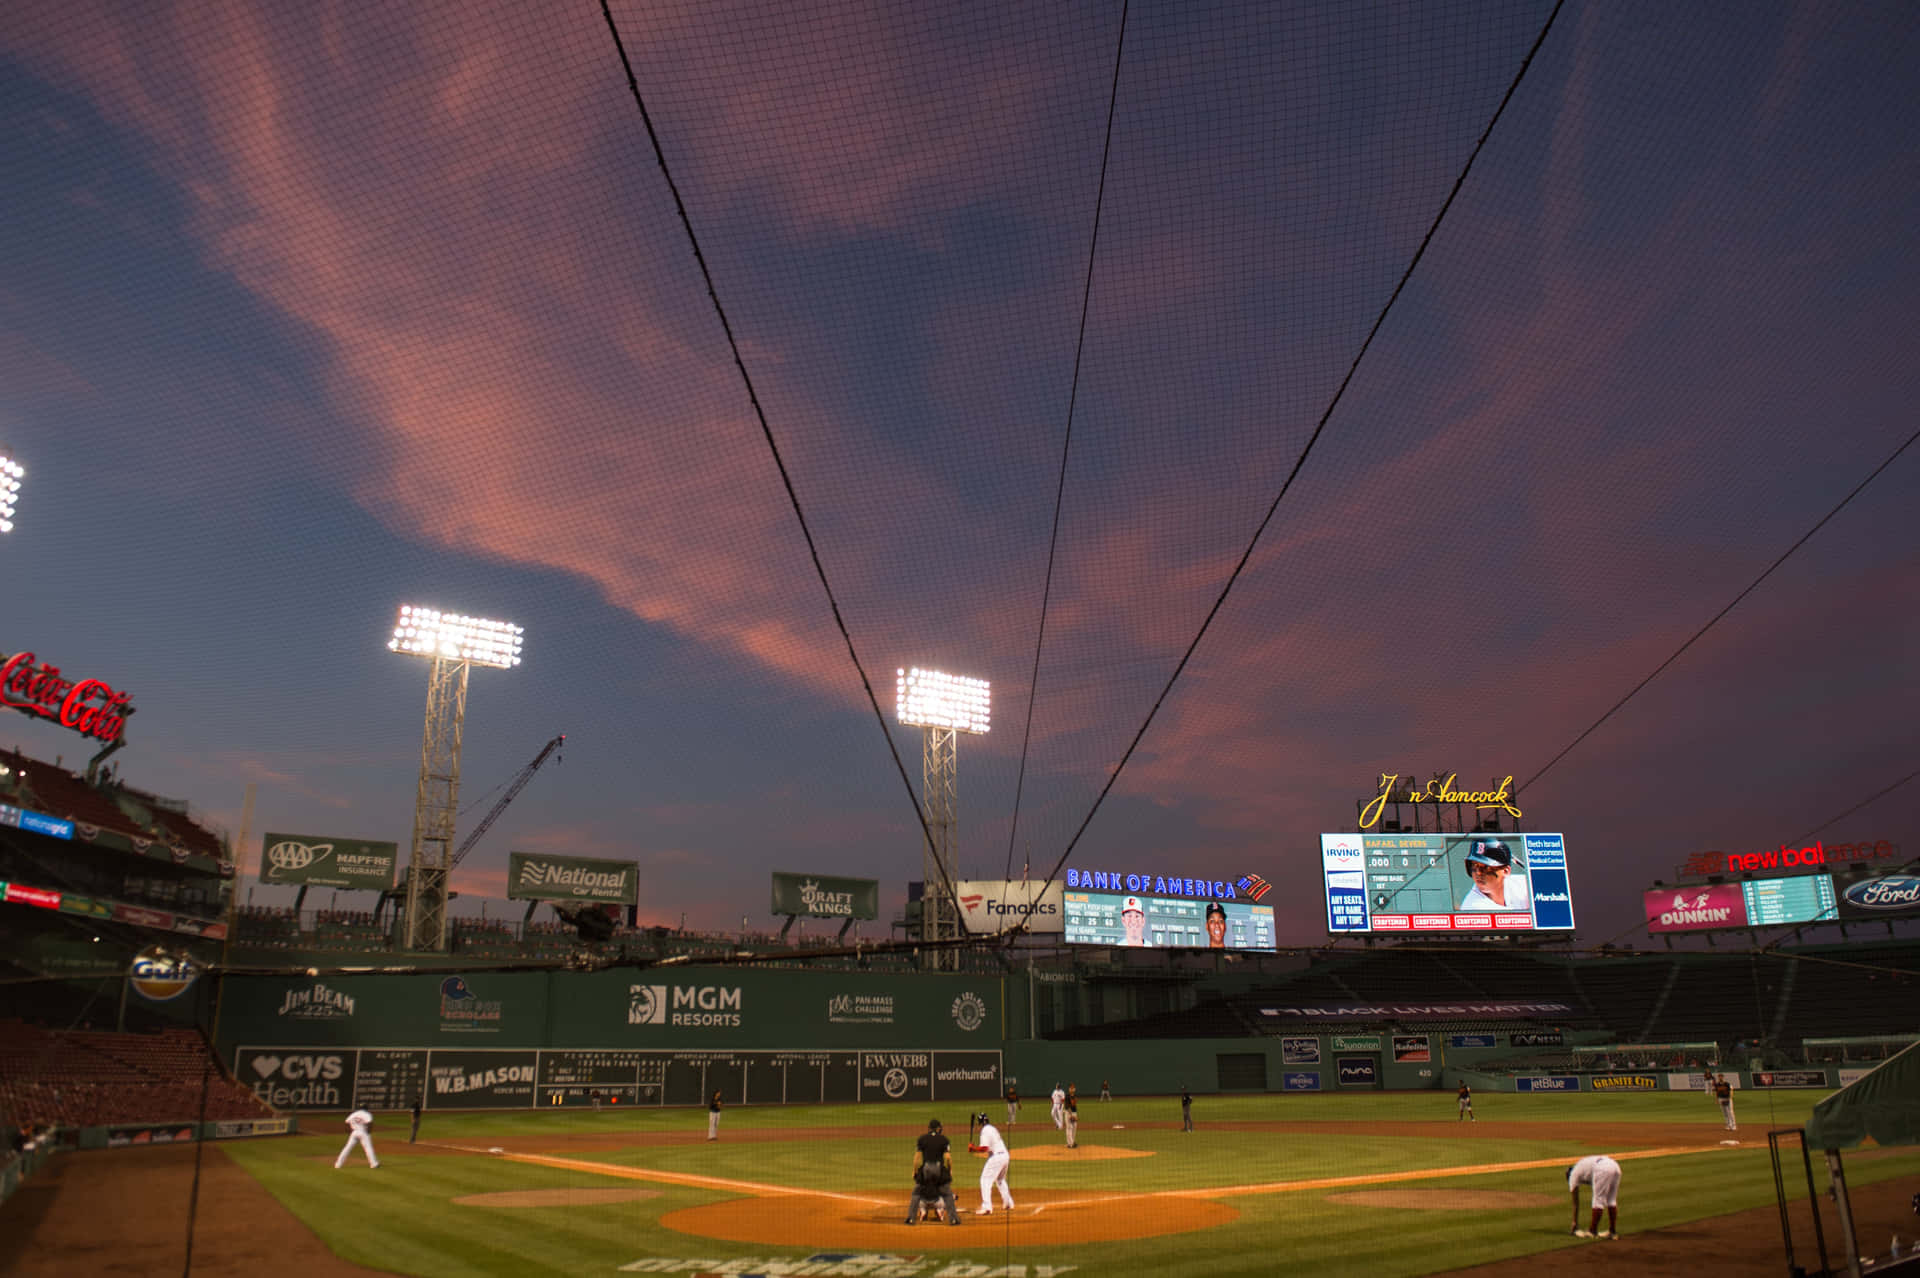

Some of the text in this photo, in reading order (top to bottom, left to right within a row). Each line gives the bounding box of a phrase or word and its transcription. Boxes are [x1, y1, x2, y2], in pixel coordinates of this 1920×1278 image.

[1426, 773, 1522, 818] Hancock
[337, 854, 391, 866] MAPFRE
[1326, 849, 1360, 857] IRVING
[1727, 840, 1893, 873] new balance
[338, 866, 388, 876] INSURANCE
[545, 865, 626, 888] National
[1067, 869, 1237, 898] BANK OF AMERICA
[572, 887, 622, 897] Car Rental
[801, 890, 854, 905] DRAFT
[1863, 880, 1920, 904] Ford
[808, 902, 852, 914] KINGS
[1660, 907, 1730, 926] DUNKIN'
[278, 984, 354, 1016] JIM BEAM
[672, 986, 742, 1010] MGM
[1303, 1007, 1390, 1016] BLACK
[1392, 1006, 1465, 1015] LIVES
[672, 1013, 741, 1026] RESORTS
[281, 1055, 342, 1079] CVS
[865, 1055, 888, 1068] F.W.
[890, 1054, 928, 1068] WEBB
[937, 1068, 994, 1081] workhuman
[1531, 1078, 1565, 1092] jetBlue
[1593, 1076, 1656, 1088] GRANITE CITY
[252, 1081, 338, 1105] Health
